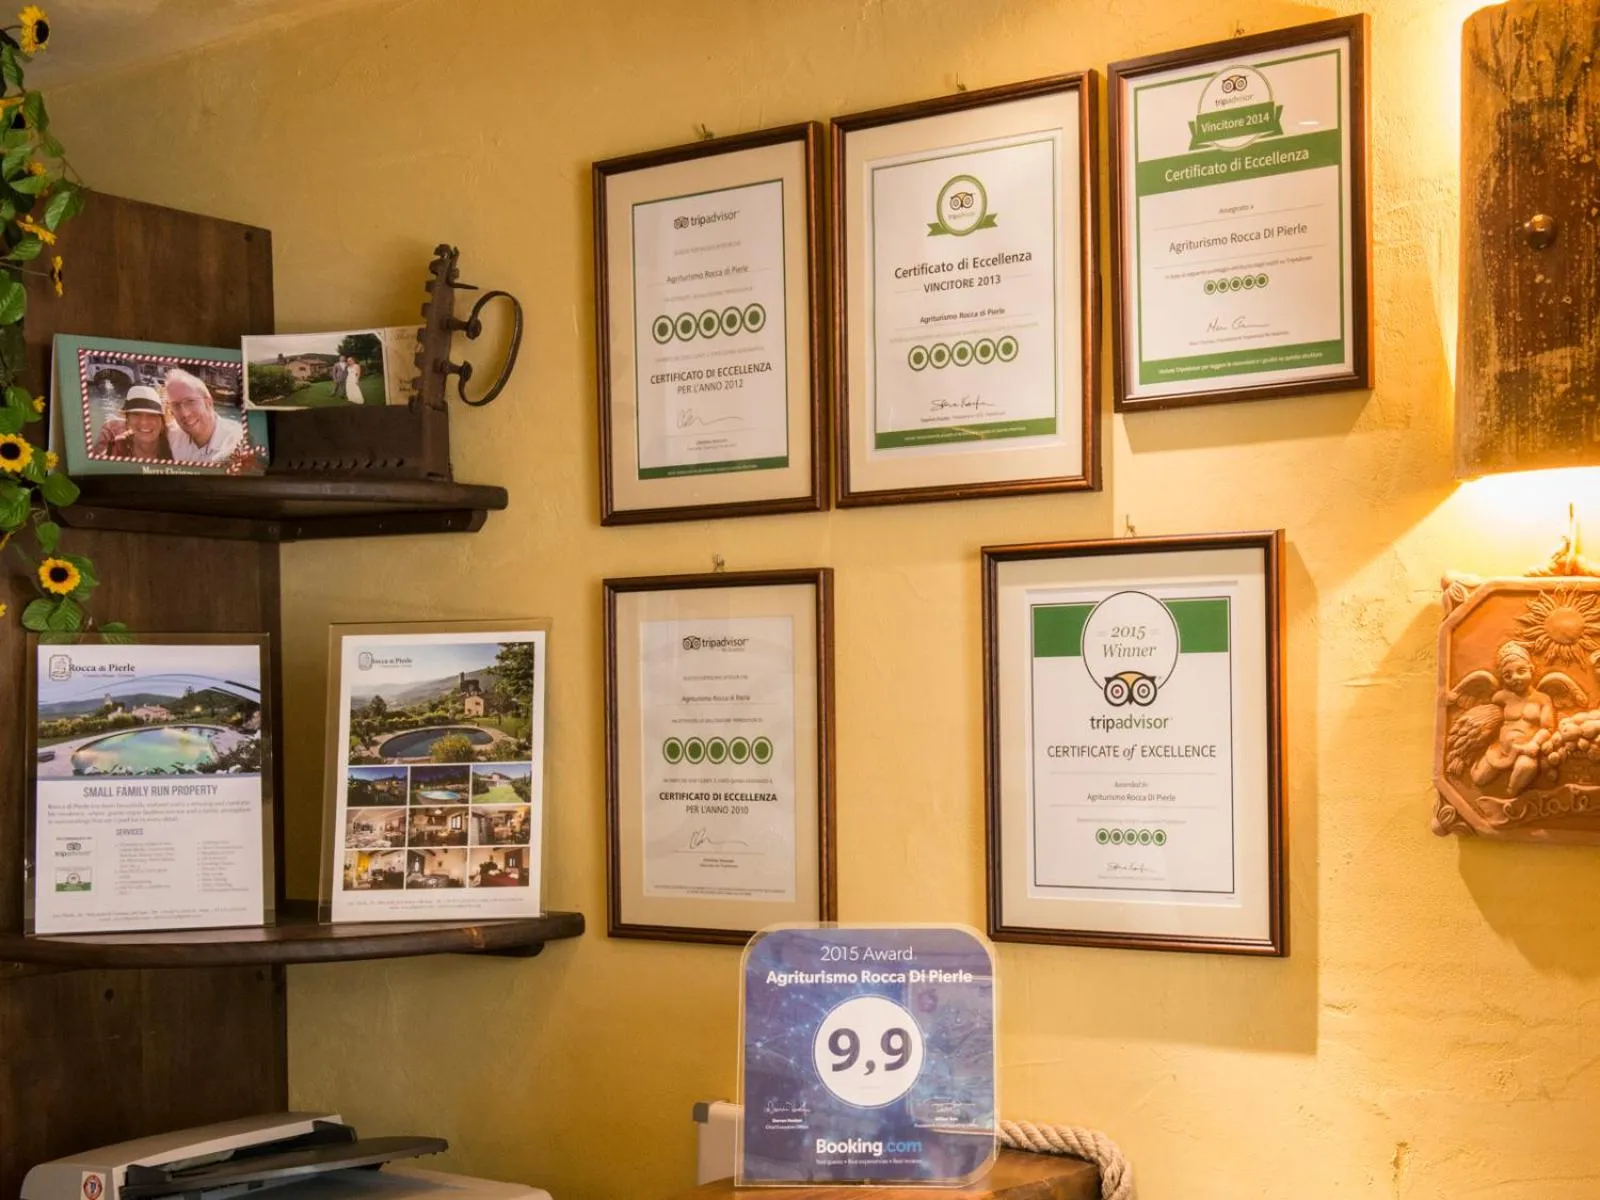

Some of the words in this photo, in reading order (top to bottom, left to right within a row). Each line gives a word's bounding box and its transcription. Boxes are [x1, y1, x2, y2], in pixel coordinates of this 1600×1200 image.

[1201, 119, 1245, 133] Vincitore
[1246, 112, 1270, 126] 2014
[1165, 164, 1228, 183] Certificato
[1230, 158, 1242, 172] di
[1244, 148, 1310, 169] Eccellenza
[690, 210, 740, 228] tripadvisor
[1169, 236, 1228, 254] Agriturismo
[1230, 230, 1261, 243] Rocca
[1263, 227, 1275, 240] DI
[1276, 223, 1308, 237] Pierle
[894, 260, 954, 279] Certificato
[957, 258, 969, 270] di
[972, 251, 1033, 269] Eccellenza
[923, 277, 975, 294] VINCITORE
[977, 274, 1001, 287] 2013
[650, 370, 704, 385] CERTIFICATO
[705, 368, 716, 379] DI
[717, 361, 773, 377] ECCELLENZA
[677, 384, 692, 395] PER
[693, 380, 722, 394] L'ANNO
[724, 379, 744, 390] 2012
[1110, 625, 1147, 639] 2015
[701, 636, 747, 649] tripadvisor
[1102, 642, 1157, 658] Winner
[68, 662, 97, 673] Rocca
[108, 662, 136, 673] Pierle
[1089, 713, 1169, 733] tripadvisor
[1047, 744, 1120, 758] CERTIFICATE
[1122, 743, 1138, 760] of
[1140, 744, 1217, 758] EXCELLENCE
[83, 786, 114, 799] SMALL
[115, 785, 149, 798] FAMILY
[150, 785, 171, 797] RUN
[171, 784, 219, 797] PROPERTY
[659, 791, 711, 801] CERTIFICATO
[712, 792, 722, 801] DI
[724, 792, 778, 802] ECCELLENZA
[1087, 792, 1126, 803] Agriturismo
[1126, 793, 1147, 802] Rocca
[1156, 793, 1177, 802] Pierle
[686, 805, 699, 815] PER
[701, 805, 729, 815] L'ANNO
[115, 828, 144, 836] SERVICES
[820, 946, 860, 962] 2015
[863, 946, 914, 962] Award
[765, 970, 858, 987] Agriturismo
[860, 969, 906, 984] Rocca
[909, 969, 926, 983] Di
[928, 969, 973, 983] Pierle
[827, 1027, 913, 1076] 9,9
[815, 1138, 922, 1157] Booking.com
